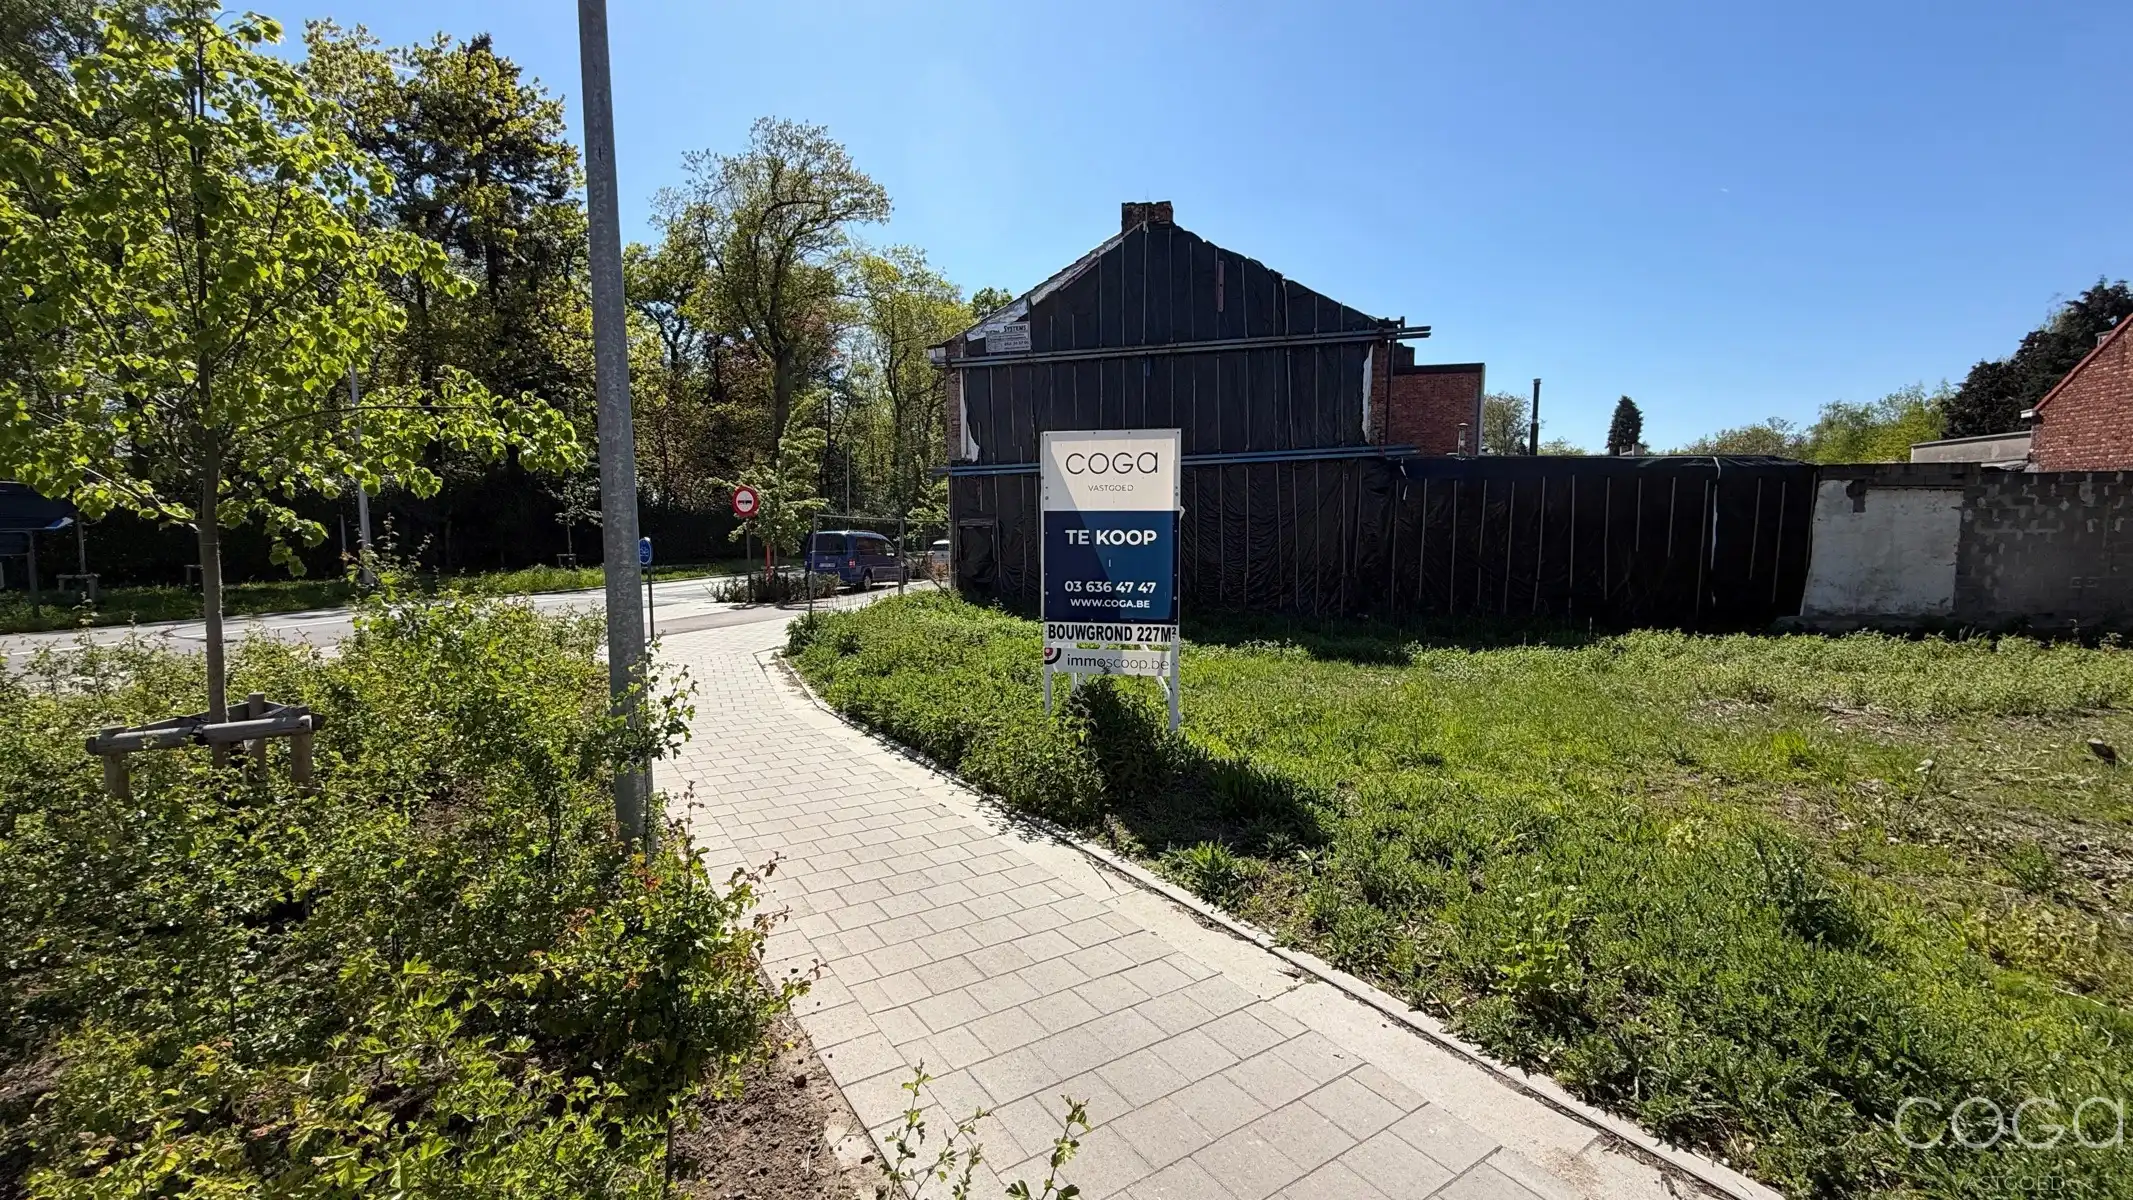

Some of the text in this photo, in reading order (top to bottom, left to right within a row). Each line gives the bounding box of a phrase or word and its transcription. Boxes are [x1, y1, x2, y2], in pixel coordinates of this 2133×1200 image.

[1088, 484, 1134, 492] VASTGOED
[1064, 529, 1158, 546] TE KOOP
[1064, 580, 1157, 594] 03 636 47 47
[1070, 598, 1151, 609] WWW.COGA.BE
[1048, 624, 1133, 642] BOUWGROND
[1067, 653, 1170, 672] immoscoop.be
